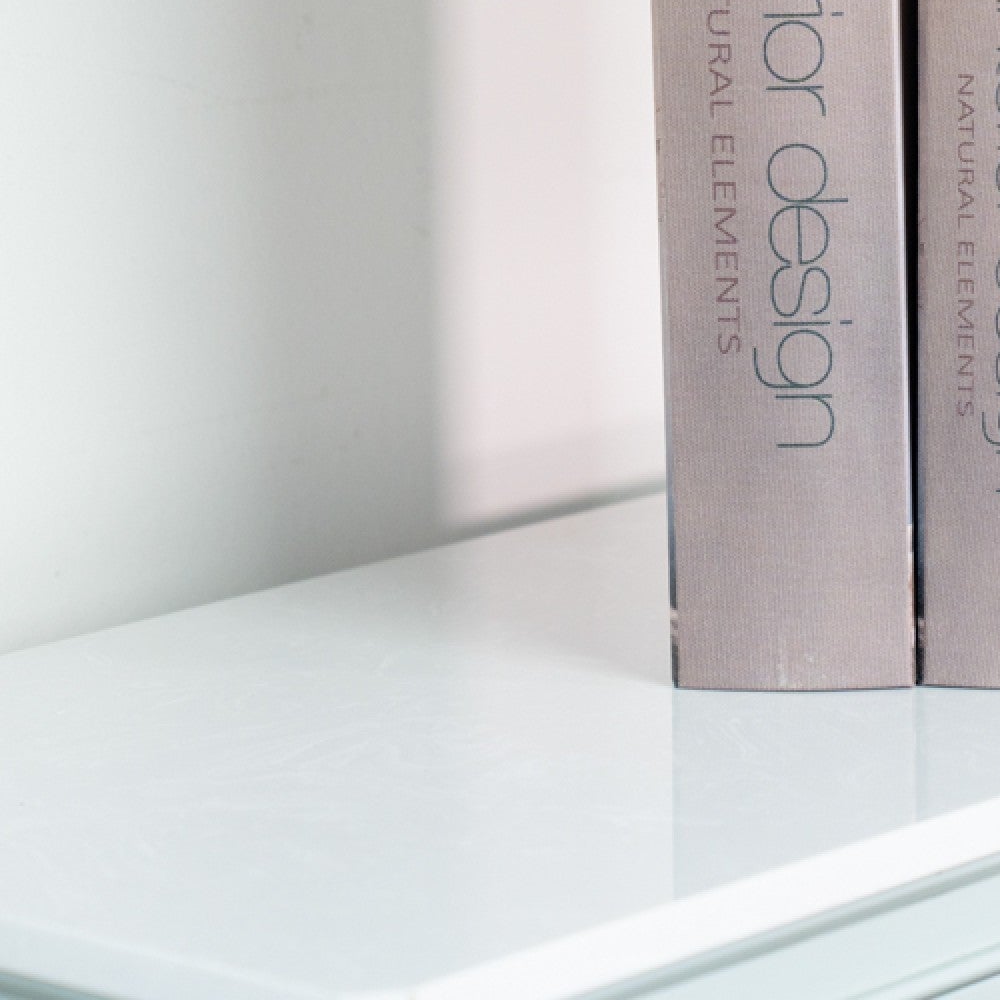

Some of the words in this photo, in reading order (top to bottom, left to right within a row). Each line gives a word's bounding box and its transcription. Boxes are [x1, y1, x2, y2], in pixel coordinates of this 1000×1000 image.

[711, 134, 741, 355] ELEMENTS
[957, 73, 975, 229] NATURAL
[753, 143, 853, 448] design
[957, 241, 975, 418] ELEMENTS
